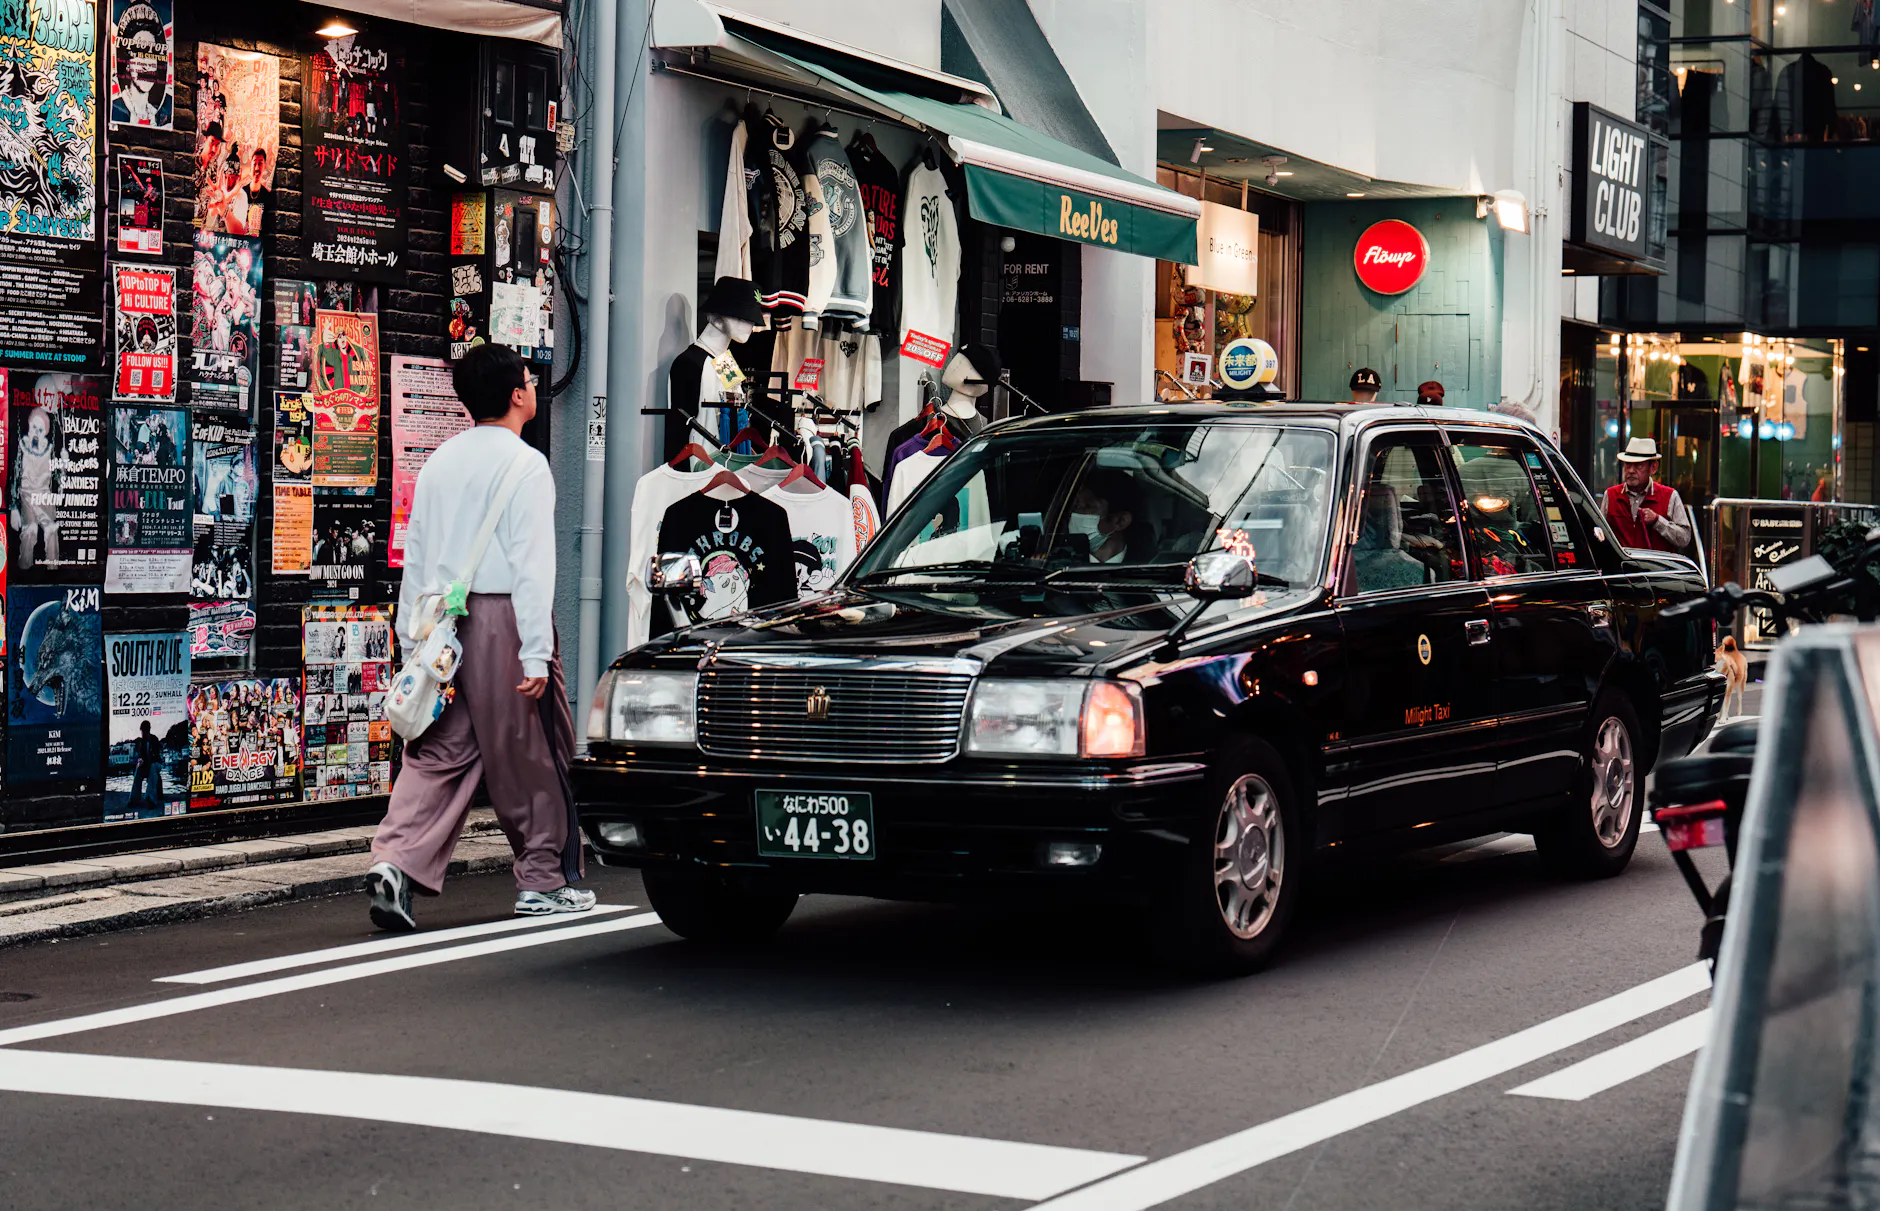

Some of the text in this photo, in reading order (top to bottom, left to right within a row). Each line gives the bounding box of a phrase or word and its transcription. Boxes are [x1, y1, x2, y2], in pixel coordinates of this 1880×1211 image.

[314, 145, 398, 177] サリドマイド
[1591, 120, 1645, 188] LIGHT
[1594, 179, 1642, 243] CLUB
[311, 242, 398, 268] 埼玉会館小ホール
[1234, 242, 1253, 262] Green
[1003, 263, 1050, 275] FOR RENT
[161, 282, 170, 295] by
[124, 294, 169, 310] Hi CULTURE
[5, 350, 34, 359] SUMMER
[35, 351, 53, 361] DAYZ
[63, 354, 87, 362] STOMP
[126, 355, 169, 369] FOLLOW US!!!
[923, 349, 944, 362] OFF
[1225, 354, 1257, 367] 未来都
[1357, 373, 1376, 385] LA
[64, 415, 99, 434] BALZAC
[60, 476, 99, 490] SANDIEST
[274, 486, 290, 497] TIME
[292, 487, 312, 498] TABLE
[64, 494, 98, 507] JUNKIES
[322, 565, 364, 580] MUST GO ON
[66, 588, 100, 612] KiM
[112, 638, 183, 678] SOUTH BLUE
[118, 690, 182, 707] 12.22 SUNHALL
[1433, 701, 1451, 720] Taxi
[192, 770, 214, 785] 11.09
[226, 766, 265, 782] DANCE
[764, 816, 871, 855] い 44-38
